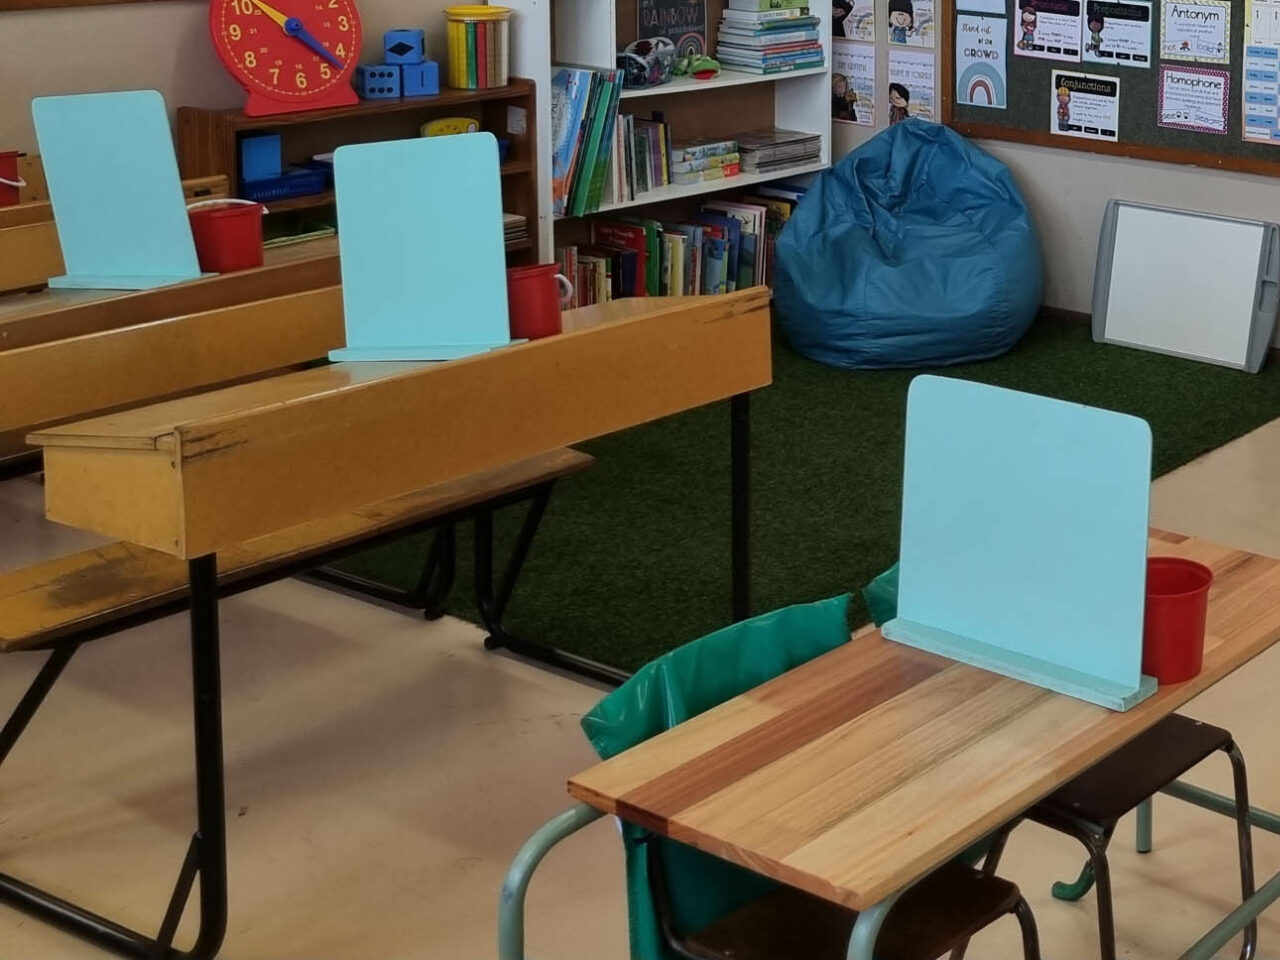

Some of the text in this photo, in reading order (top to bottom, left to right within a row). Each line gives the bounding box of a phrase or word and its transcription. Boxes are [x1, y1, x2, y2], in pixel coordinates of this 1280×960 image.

[1171, 5, 1220, 24] Antonym
[337, 15, 349, 31] 3
[229, 24, 241, 41] 9
[335, 42, 346, 58] 4
[964, 48, 999, 60] CROWD
[244, 51, 257, 68] 8
[269, 68, 280, 85] 7
[320, 63, 331, 79] 5
[295, 72, 307, 88] 6
[1060, 77, 1111, 92] Conjunctions
[1166, 72, 1222, 89] Homophone
